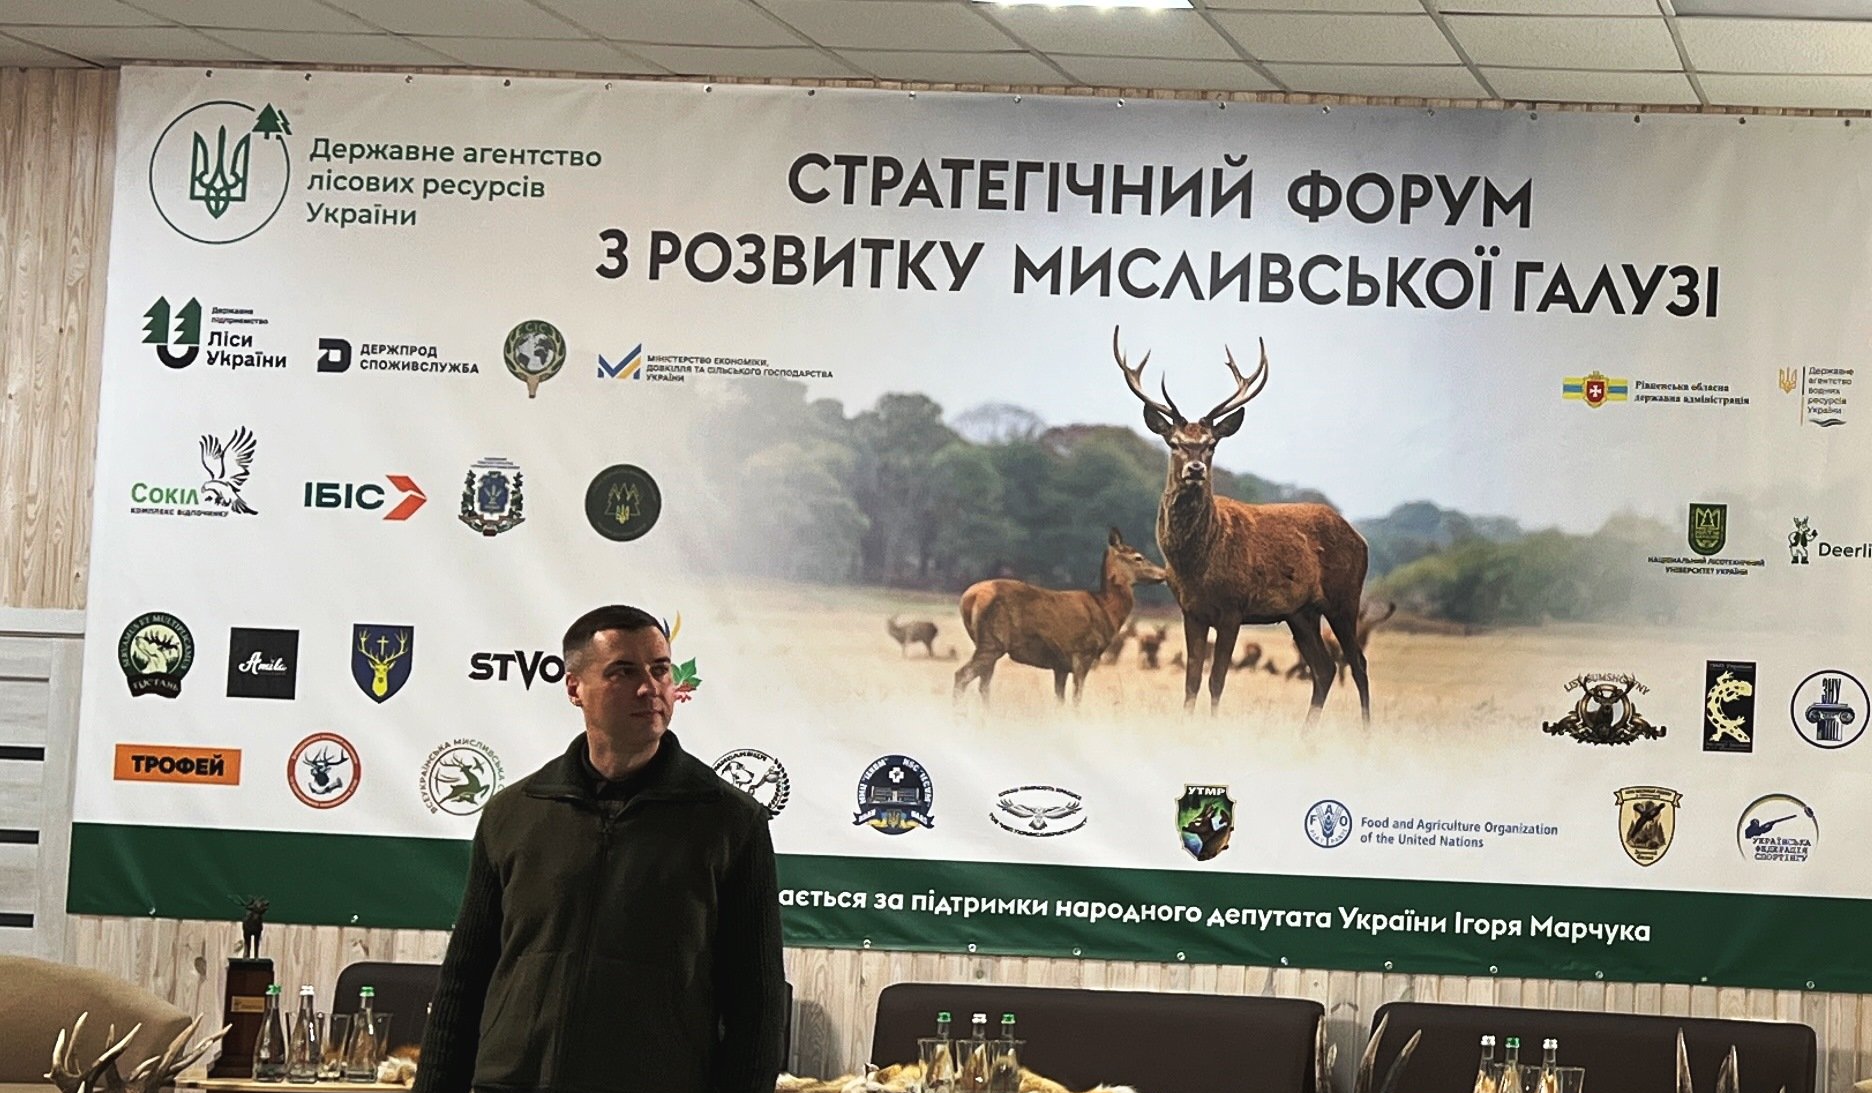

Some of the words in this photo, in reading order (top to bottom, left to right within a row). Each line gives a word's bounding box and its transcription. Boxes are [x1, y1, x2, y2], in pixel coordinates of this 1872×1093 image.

[309, 137, 456, 164] Державне
[462, 147, 602, 169] агентство
[307, 170, 415, 195] лісових
[422, 174, 546, 200] ресурсів
[788, 152, 1254, 220] СТРАТЕГІЧНИЙ
[1287, 168, 1533, 229] ФОРУМ
[305, 202, 418, 228] України
[595, 228, 629, 280] З
[648, 230, 985, 292] РОЗВИТКУ
[1013, 242, 1502, 312] МИСЛИВСЬКОЇ
[1513, 261, 1719, 318] ГАЛУЗІ
[207, 330, 254, 348] Ліси
[360, 342, 438, 359] ДЕРЖПРОД
[206, 350, 288, 371] України
[360, 359, 479, 375] СПОЖИВСЛУЖБА
[468, 649, 566, 692] STVO
[131, 752, 227, 777] ТРОФЕЙ
[1360, 815, 1389, 830] Food
[1392, 817, 1414, 831] and
[1417, 819, 1481, 836] Agriculture
[1484, 821, 1559, 838] Organization
[1360, 832, 1374, 845] of
[1375, 833, 1395, 846] the
[1398, 833, 1437, 848] United
[1440, 834, 1485, 849] Nations
[778, 888, 868, 910] ається
[873, 892, 904, 911] за
[911, 888, 1049, 919] підтримки
[1055, 898, 1203, 924] народного
[1206, 908, 1332, 931] депутата
[1338, 906, 1448, 934] України
[1454, 910, 1523, 938] Ігоря
[1530, 914, 1652, 943] Марчука
